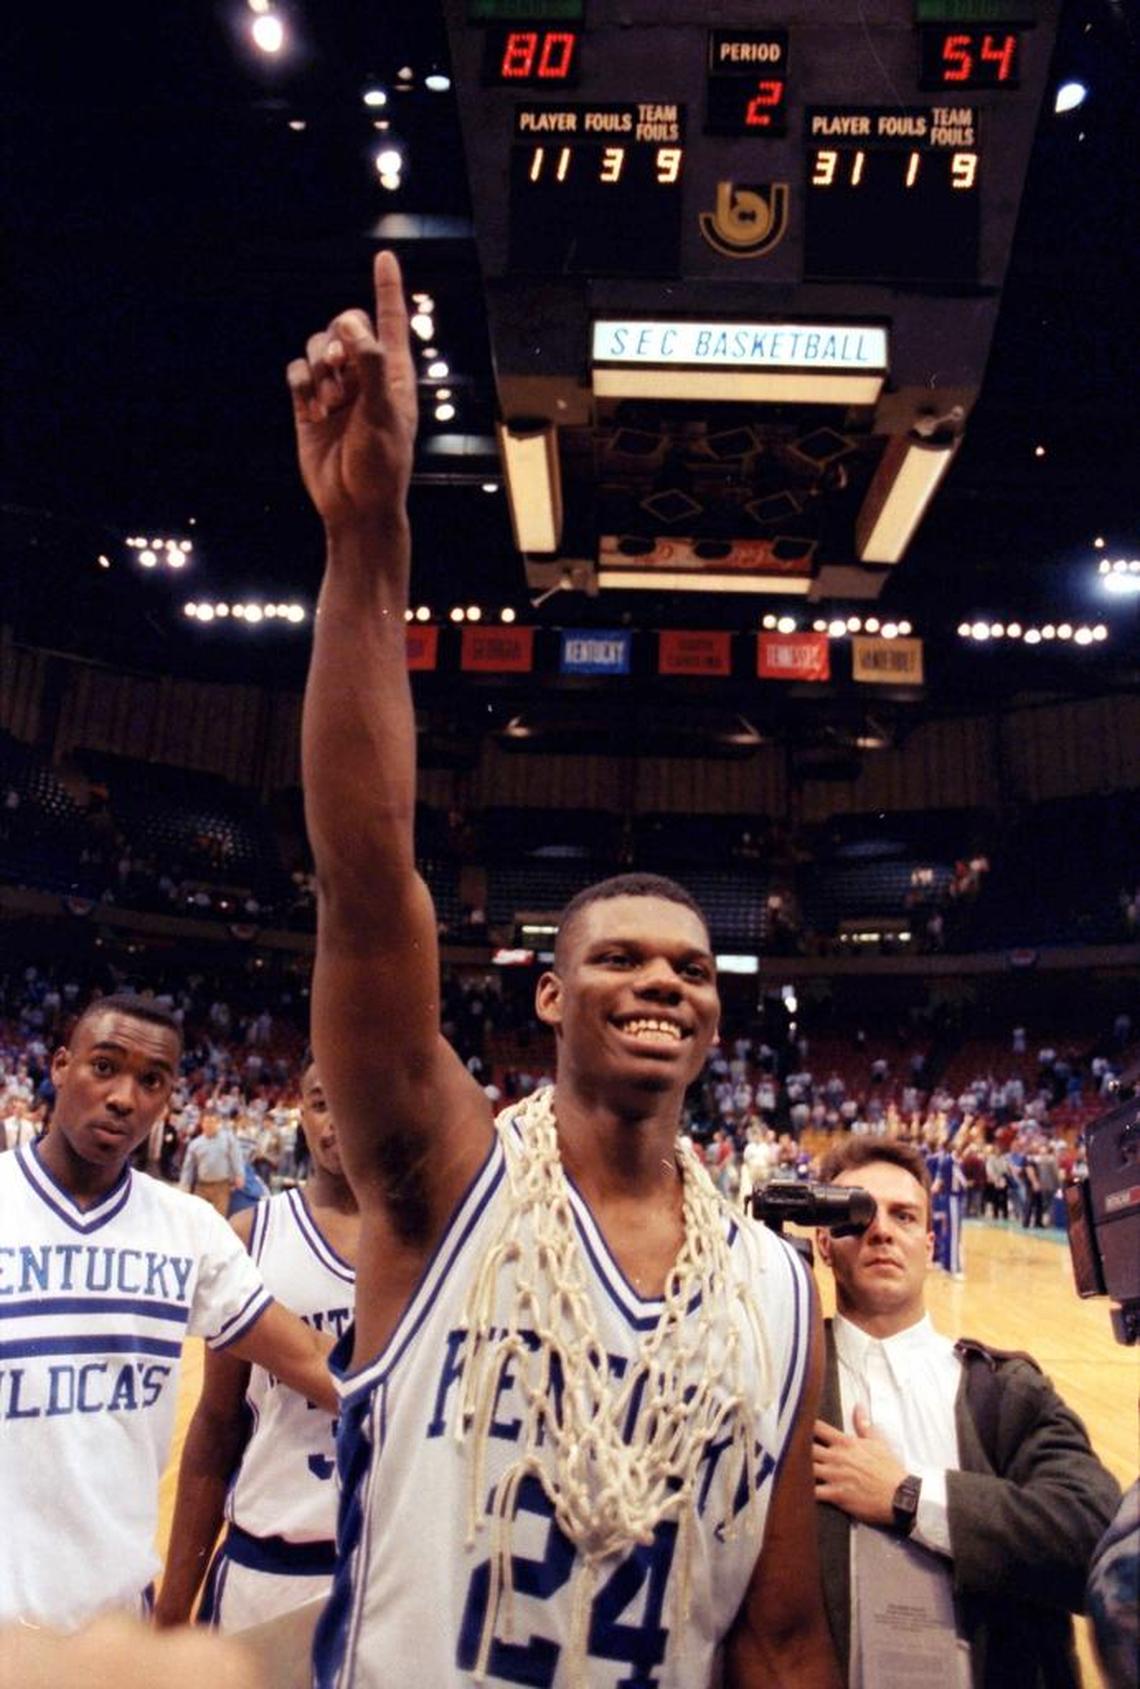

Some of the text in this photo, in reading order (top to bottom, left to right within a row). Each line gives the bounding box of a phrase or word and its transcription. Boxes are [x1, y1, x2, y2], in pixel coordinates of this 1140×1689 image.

[502, 33, 576, 77] 80
[719, 43, 781, 62] PERIOD
[943, 35, 1016, 80] 54
[638, 104, 677, 123] TEAM
[745, 81, 784, 125] 2
[520, 113, 632, 132] PLAYER FOULS
[812, 116, 927, 136] PLAYER FOULS
[933, 107, 973, 127] TEAM
[636, 124, 679, 142] FOULS
[930, 127, 974, 146] FOULS
[600, 148, 624, 183] 3
[657, 149, 682, 183] 9
[812, 151, 978, 188] 31 1 9
[610, 328, 870, 361] SEC BASKETBALL
[564, 639, 625, 665] KENTUCKY
[456, 1474, 684, 1689] 24
